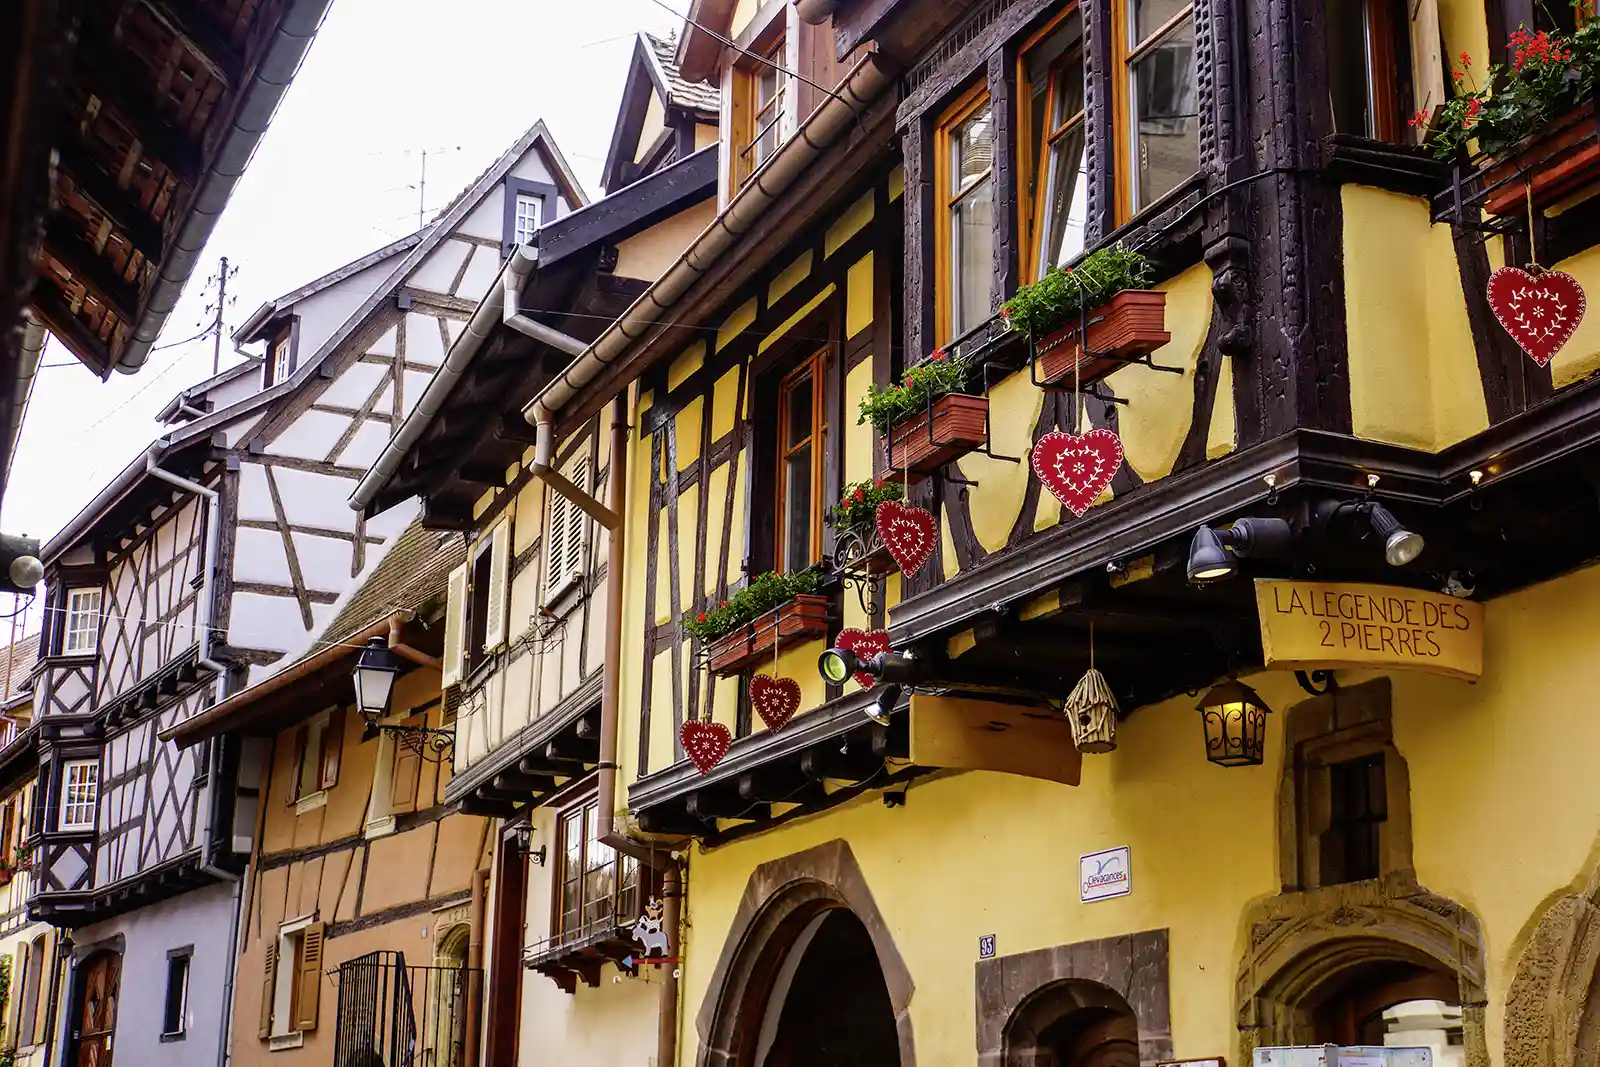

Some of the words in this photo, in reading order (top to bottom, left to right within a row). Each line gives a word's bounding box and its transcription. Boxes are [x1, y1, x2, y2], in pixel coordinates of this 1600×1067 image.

[1274, 587, 1307, 615] LA
[1310, 591, 1419, 626] LEGENDE
[1424, 601, 1470, 631] DES
[1319, 620, 1334, 647] 2
[1341, 622, 1441, 657] PIERRES
[981, 938, 993, 955] 93
